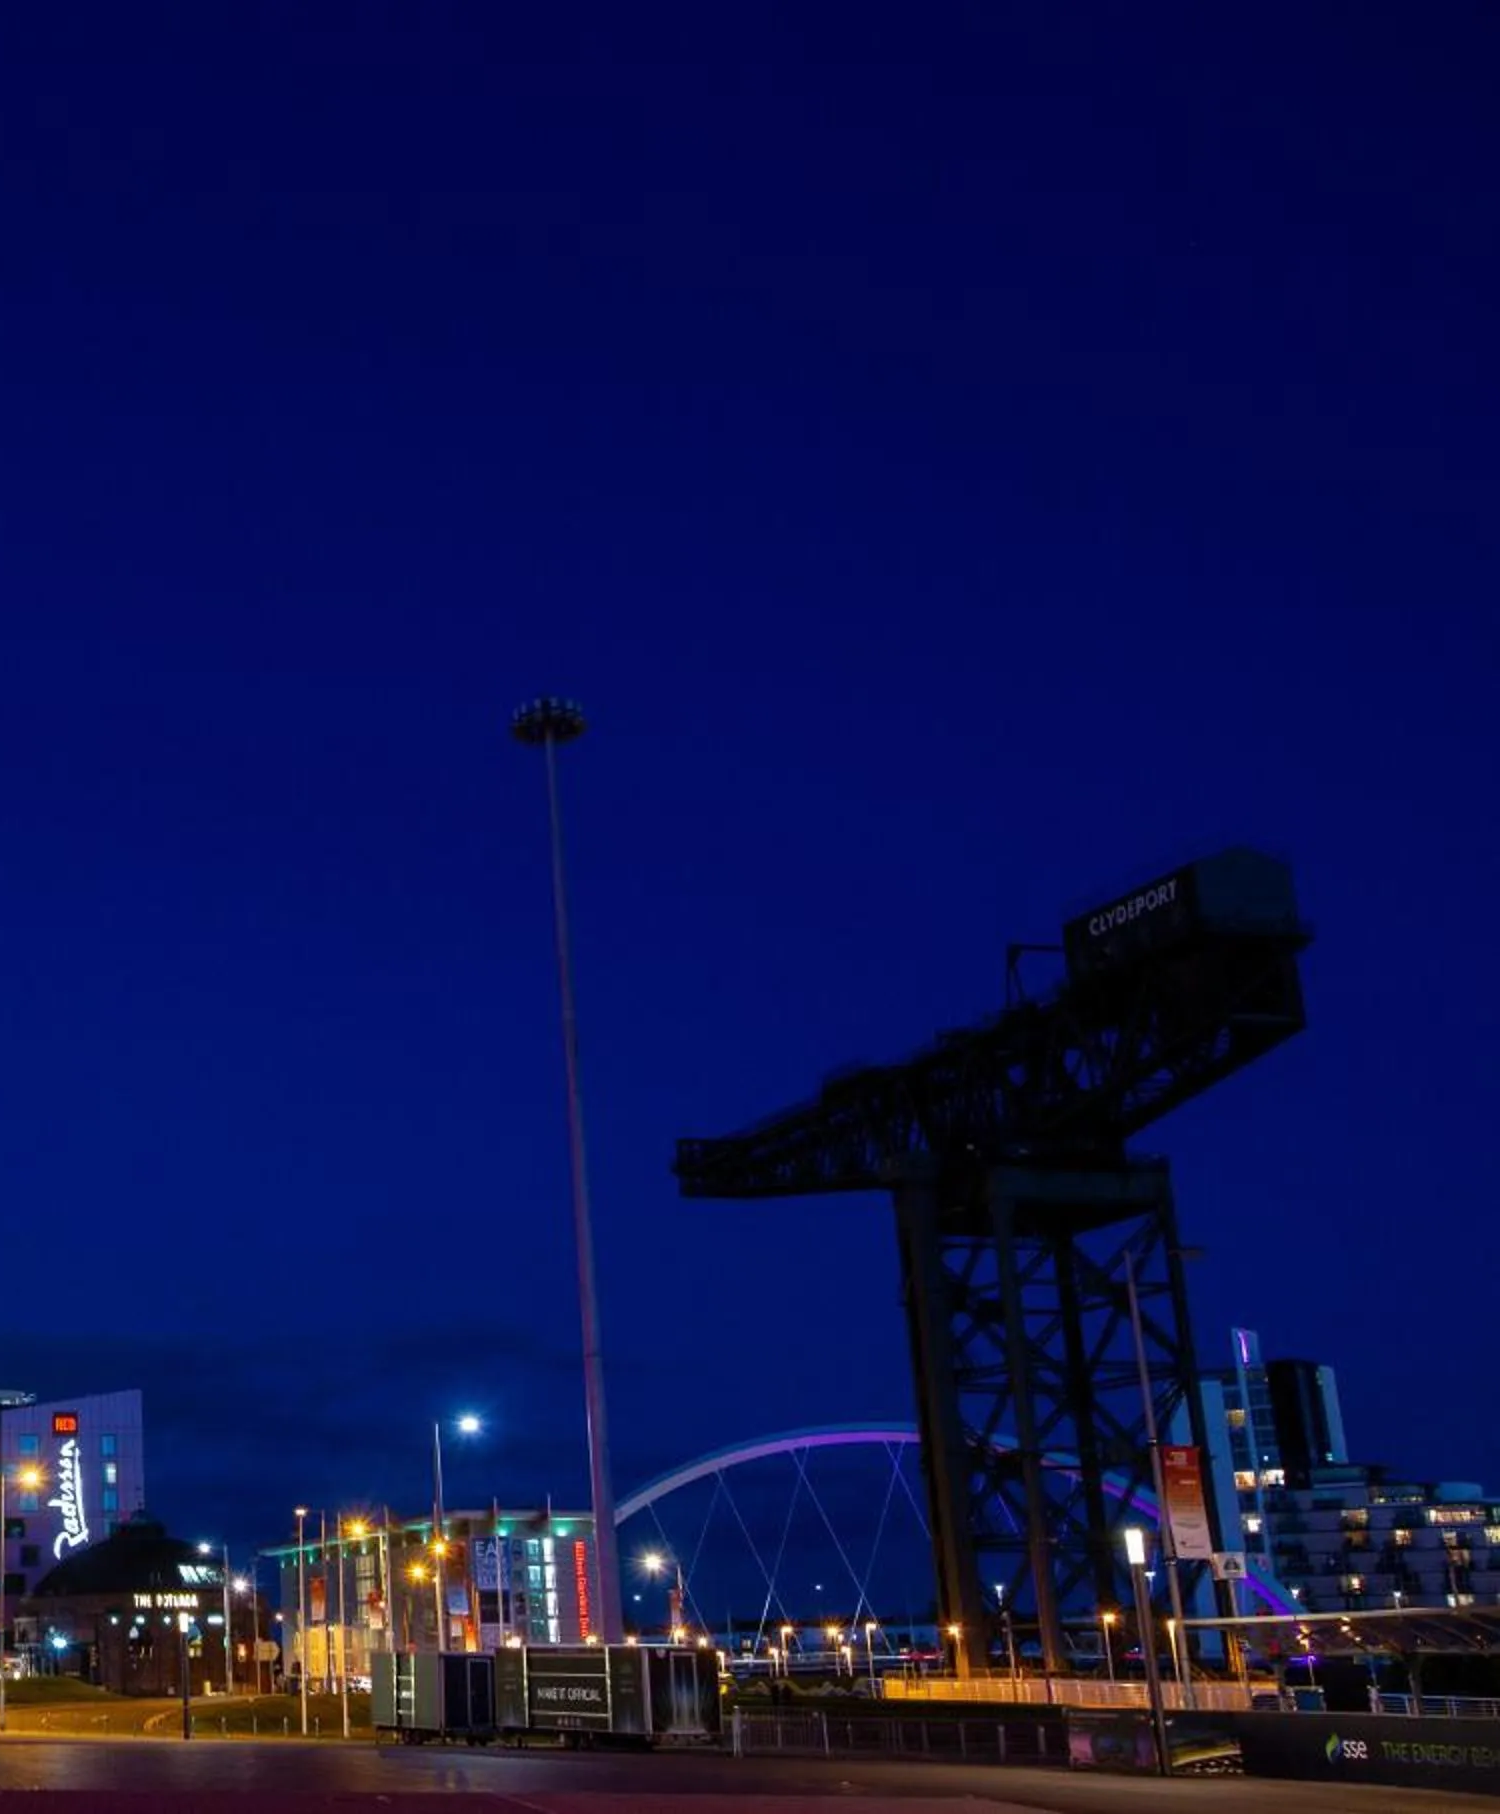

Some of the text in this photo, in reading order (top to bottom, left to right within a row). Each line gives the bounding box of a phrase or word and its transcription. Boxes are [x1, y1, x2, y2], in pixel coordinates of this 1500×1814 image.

[1088, 877, 1178, 936] CLYDEPORT
[48, 1439, 88, 1560] Radisson
[133, 1593, 152, 1608] THE
[567, 1687, 601, 1701] OFFICIAL
[1342, 1740, 1368, 1759] sse
[1379, 1741, 1408, 1762] THE
[1411, 1743, 1467, 1767] ENERGY
